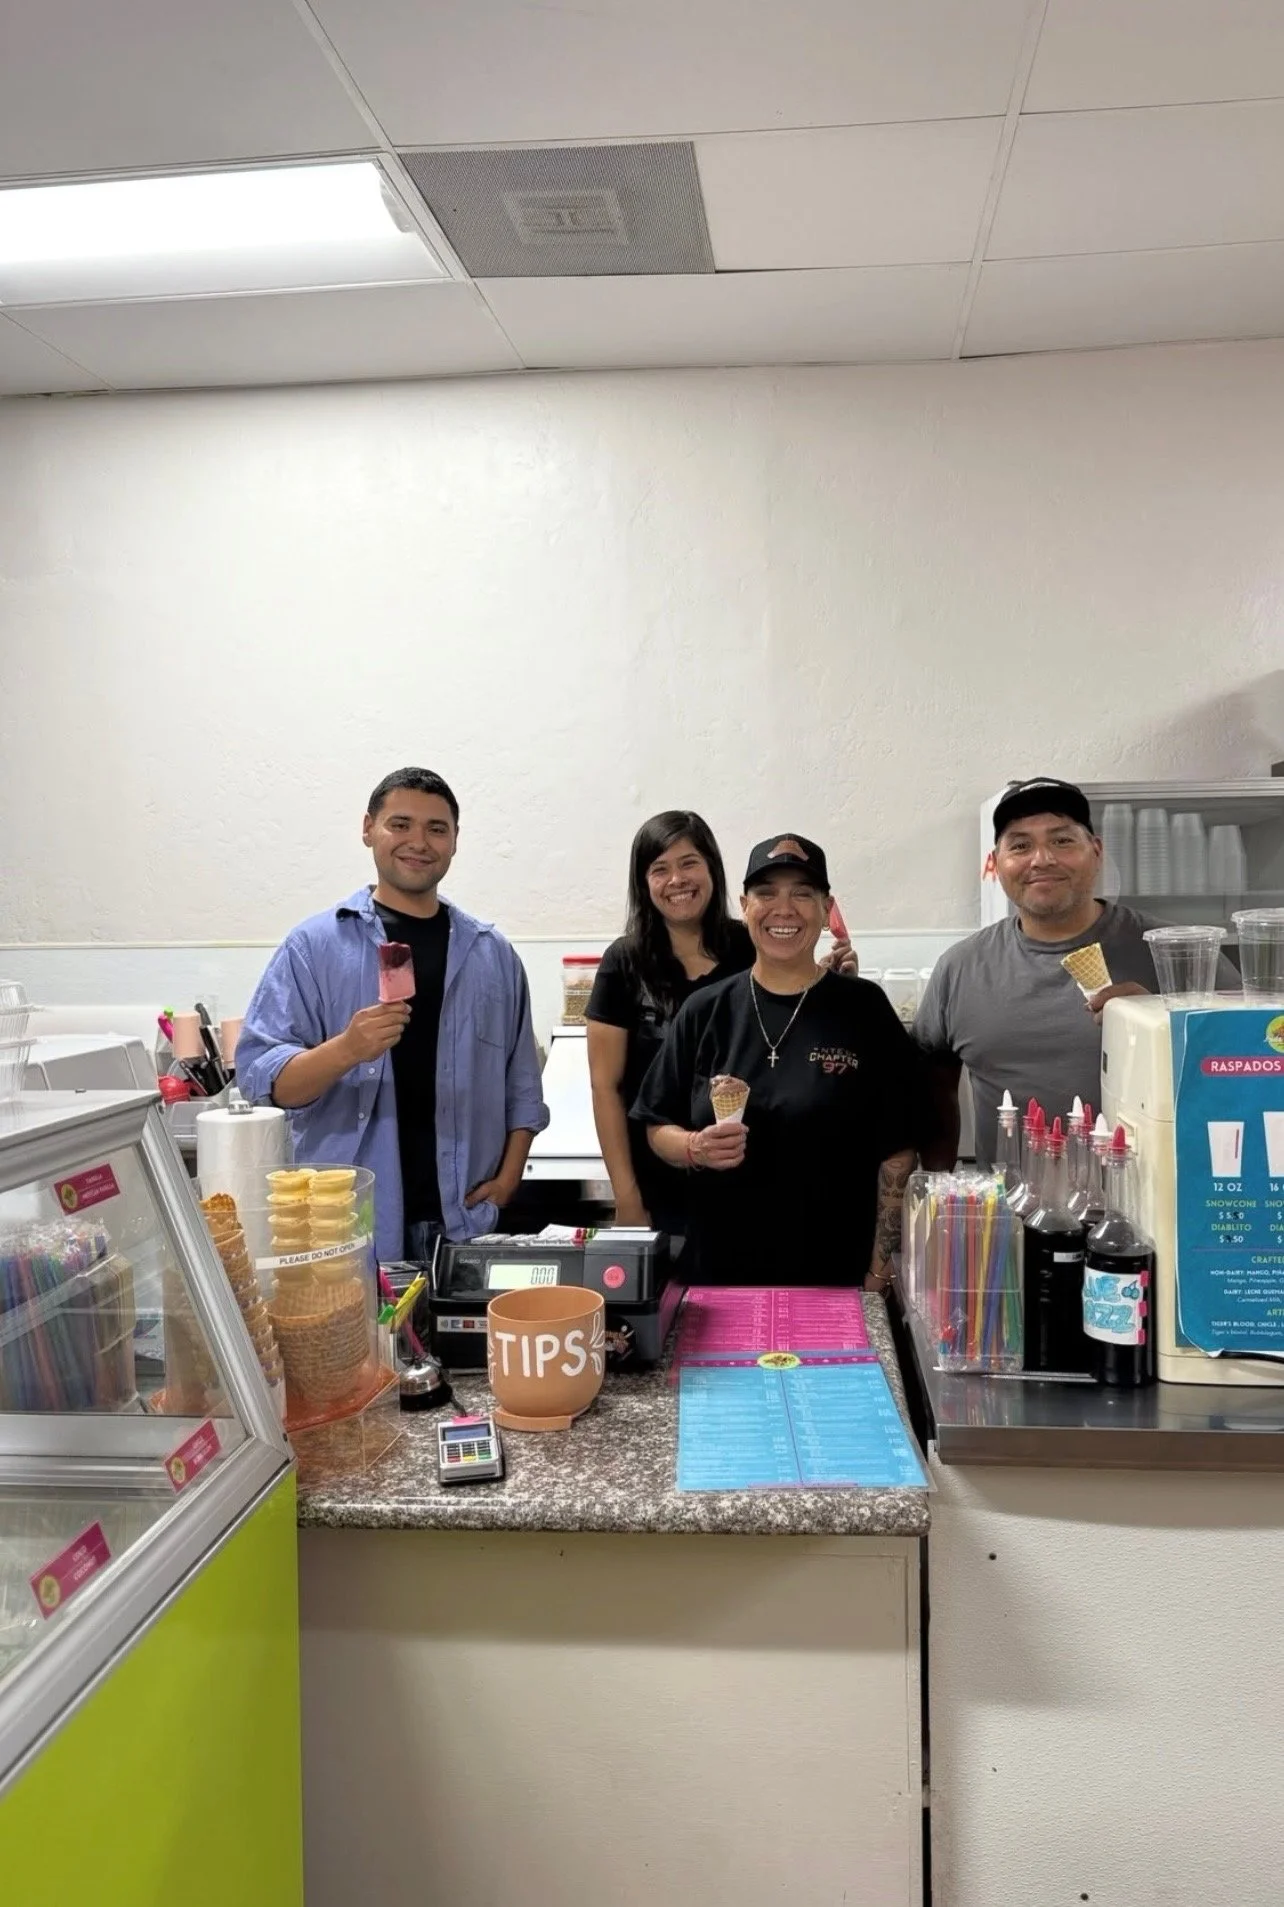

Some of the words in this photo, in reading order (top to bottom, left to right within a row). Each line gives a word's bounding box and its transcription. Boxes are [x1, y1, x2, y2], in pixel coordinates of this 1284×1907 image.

[809, 1052, 859, 1069] CHAPTER
[823, 1062, 847, 1074] 97
[1210, 1061, 1281, 1072] RASPADOS
[1213, 1182, 1224, 1192] 12
[1227, 1182, 1243, 1192] OZ
[1269, 1182, 1280, 1192] 16
[1206, 1200, 1257, 1208] SNOWCONE
[1265, 1200, 1284, 1208] SNO
[1211, 1223, 1252, 1231] DIABLITO
[279, 1254, 310, 1266] PLEASE
[311, 1251, 323, 1260] DO
[323, 1247, 338, 1257] NOT
[338, 1242, 356, 1254] OPEN
[495, 1329, 587, 1378] TIPS
